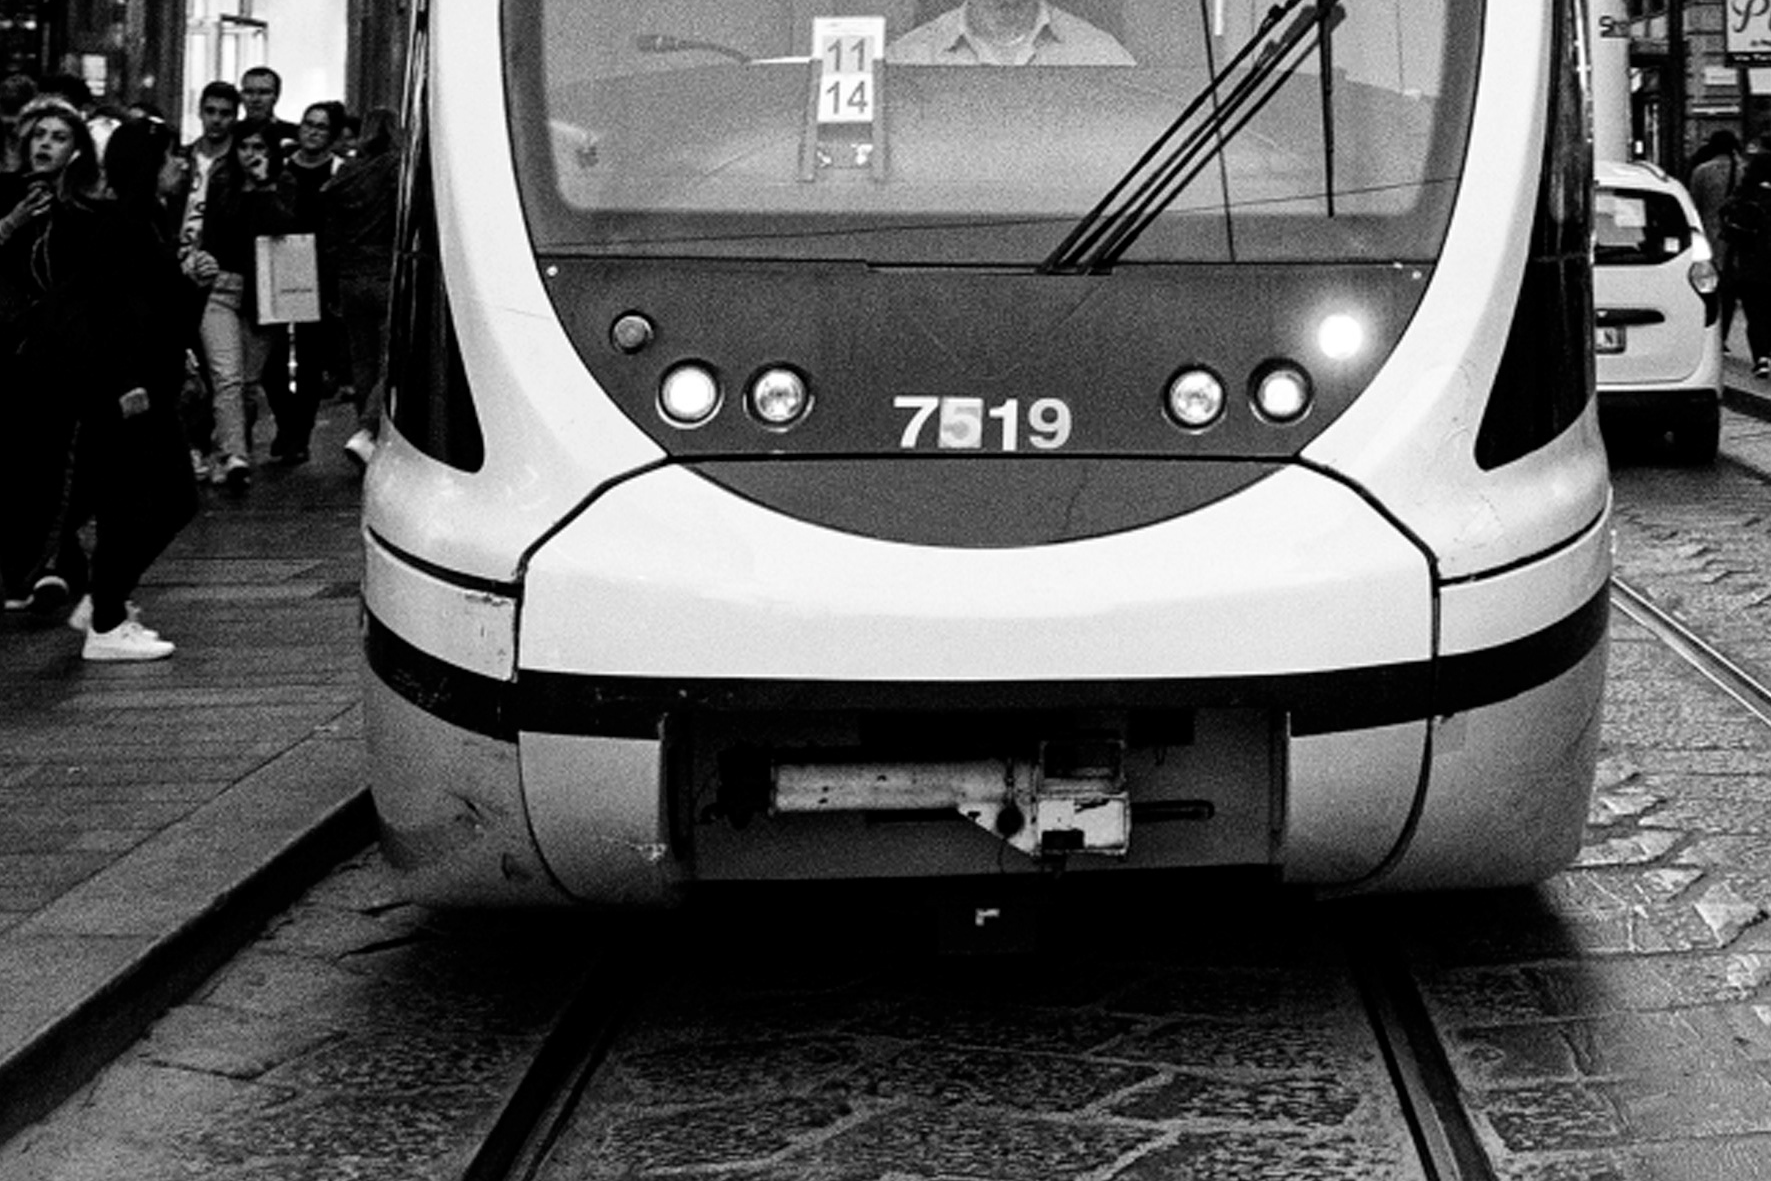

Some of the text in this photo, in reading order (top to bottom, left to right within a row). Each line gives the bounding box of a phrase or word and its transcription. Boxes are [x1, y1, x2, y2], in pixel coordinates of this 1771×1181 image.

[827, 38, 866, 72] 11
[826, 80, 869, 114] 14
[894, 396, 1071, 451] 7519
